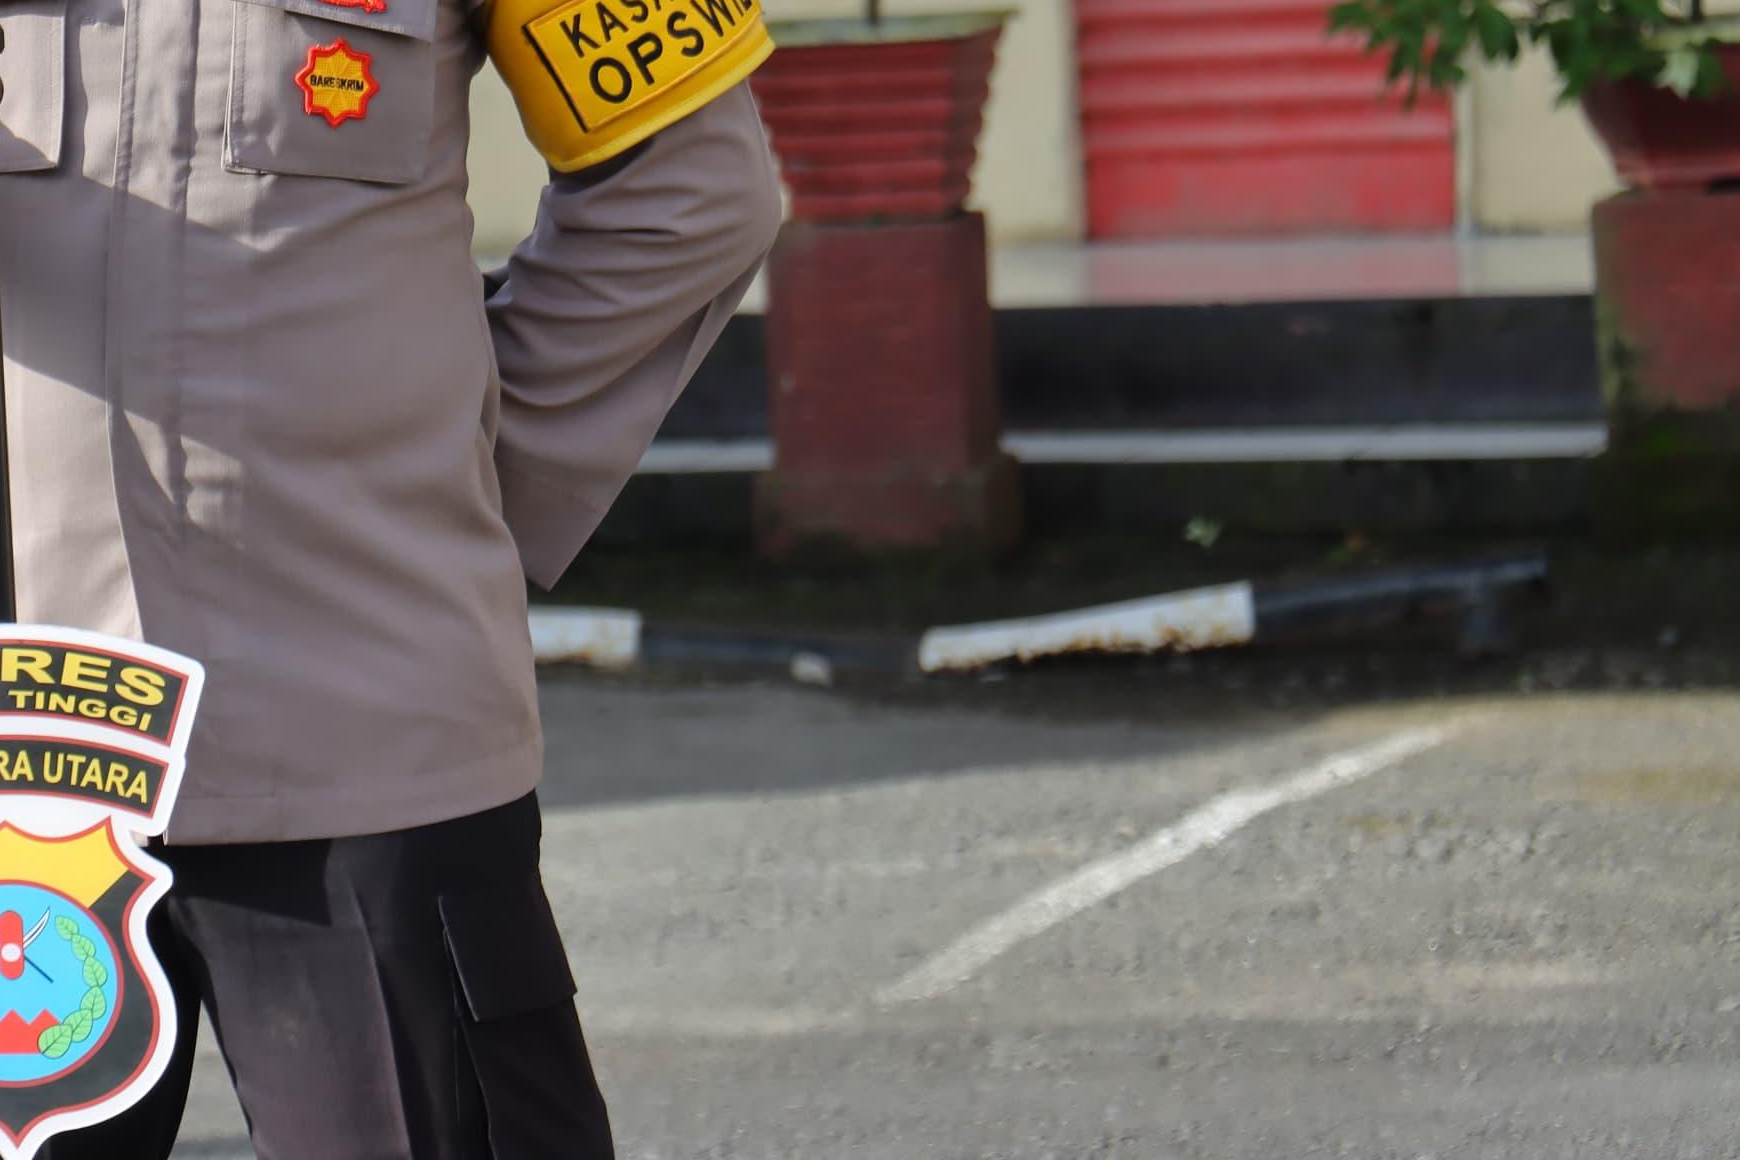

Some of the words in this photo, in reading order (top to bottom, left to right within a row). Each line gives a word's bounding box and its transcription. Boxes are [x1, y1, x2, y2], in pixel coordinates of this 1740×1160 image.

[309, 74, 365, 92] BARESKRIM
[7, 688, 152, 733] TINGGI
[42, 750, 149, 804] UTARA
